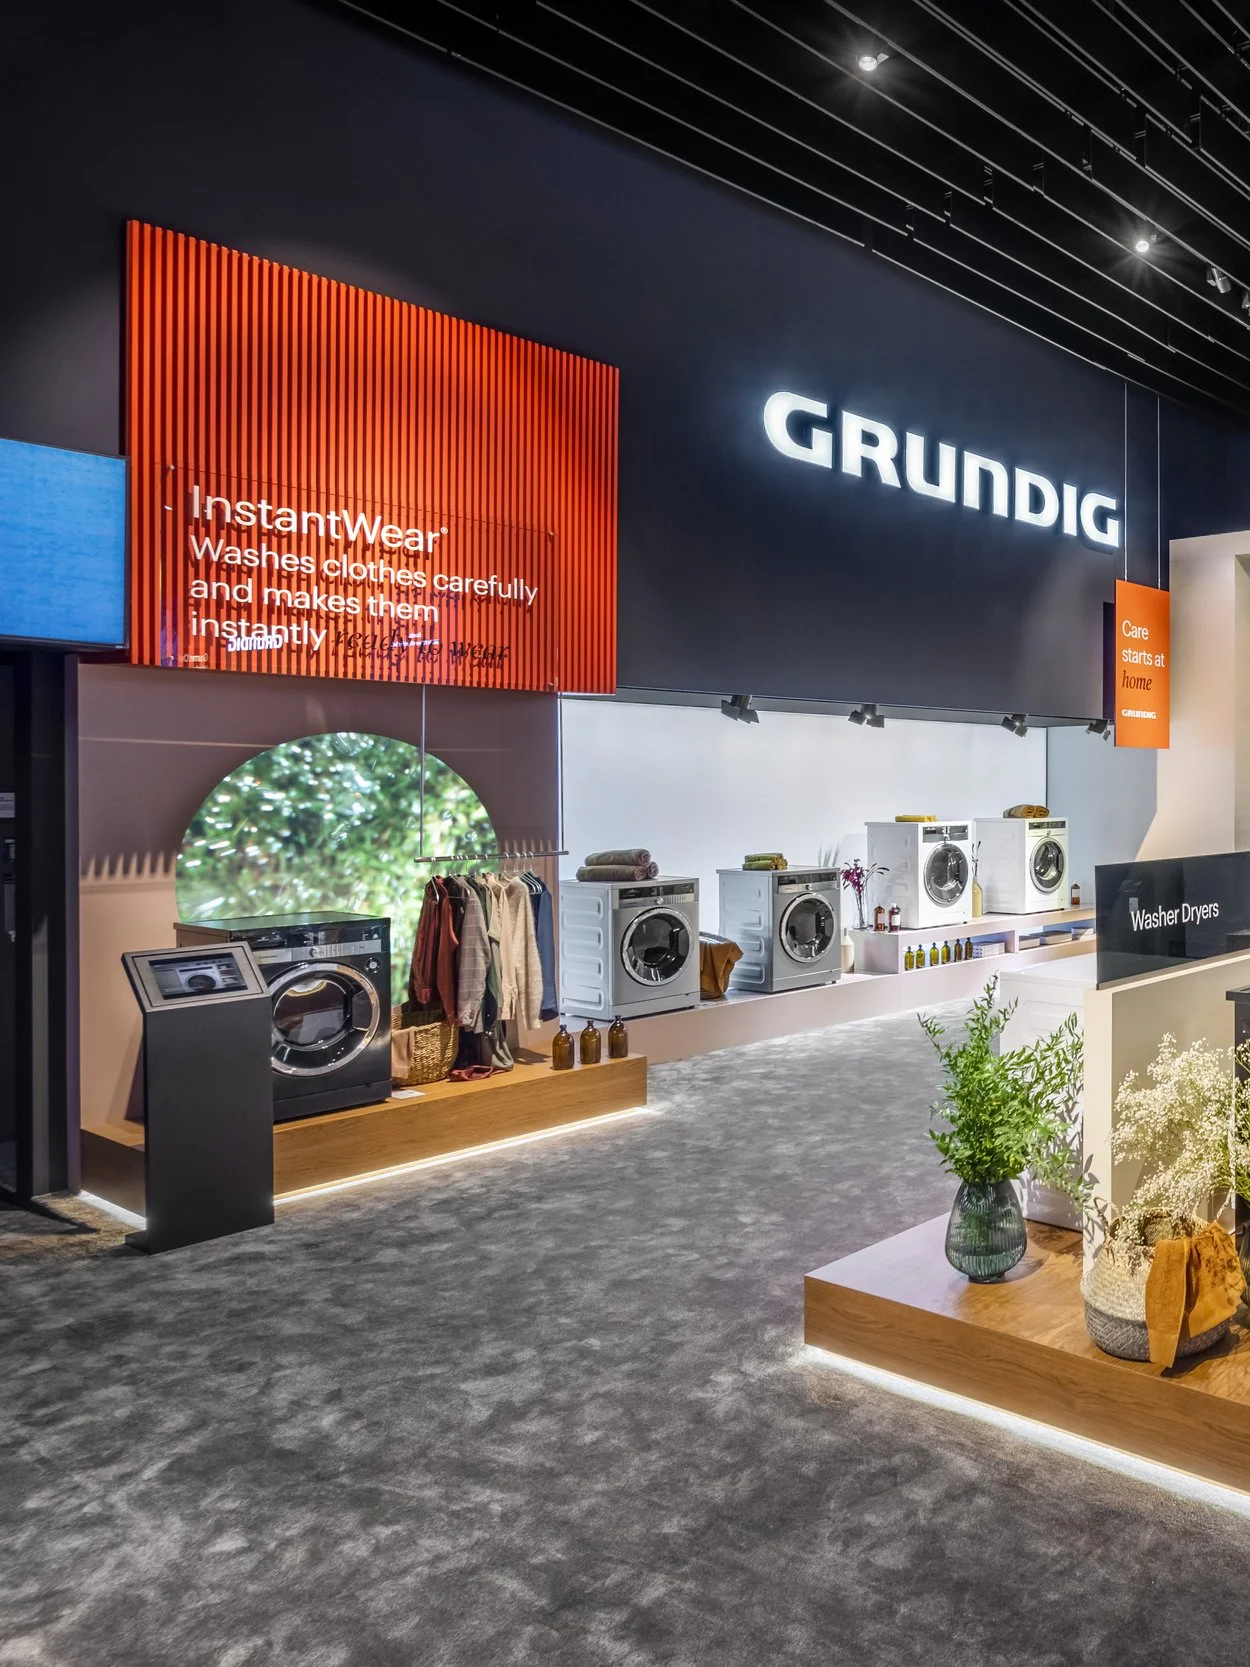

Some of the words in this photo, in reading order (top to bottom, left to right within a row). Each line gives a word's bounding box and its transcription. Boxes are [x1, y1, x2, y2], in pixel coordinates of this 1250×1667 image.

[763, 391, 1119, 548] GRUNDIG
[190, 535, 316, 574] Washes
[322, 553, 427, 588] clothes
[433, 573, 538, 605] carefully
[190, 578, 253, 603] and
[263, 585, 361, 614] makes
[368, 593, 439, 622] them
[191, 611, 327, 651] instantly
[332, 629, 412, 657] ready
[418, 634, 443, 656] to
[450, 641, 511, 661] wear
[1122, 620, 1149, 641] Care
[1122, 649, 1152, 666] starts
[1154, 653, 1165, 668] at
[1122, 670, 1152, 691] home
[1121, 709, 1157, 719] GRUNDIG
[1131, 890, 1180, 932] Washer
[1181, 902, 1219, 925] Dryers
